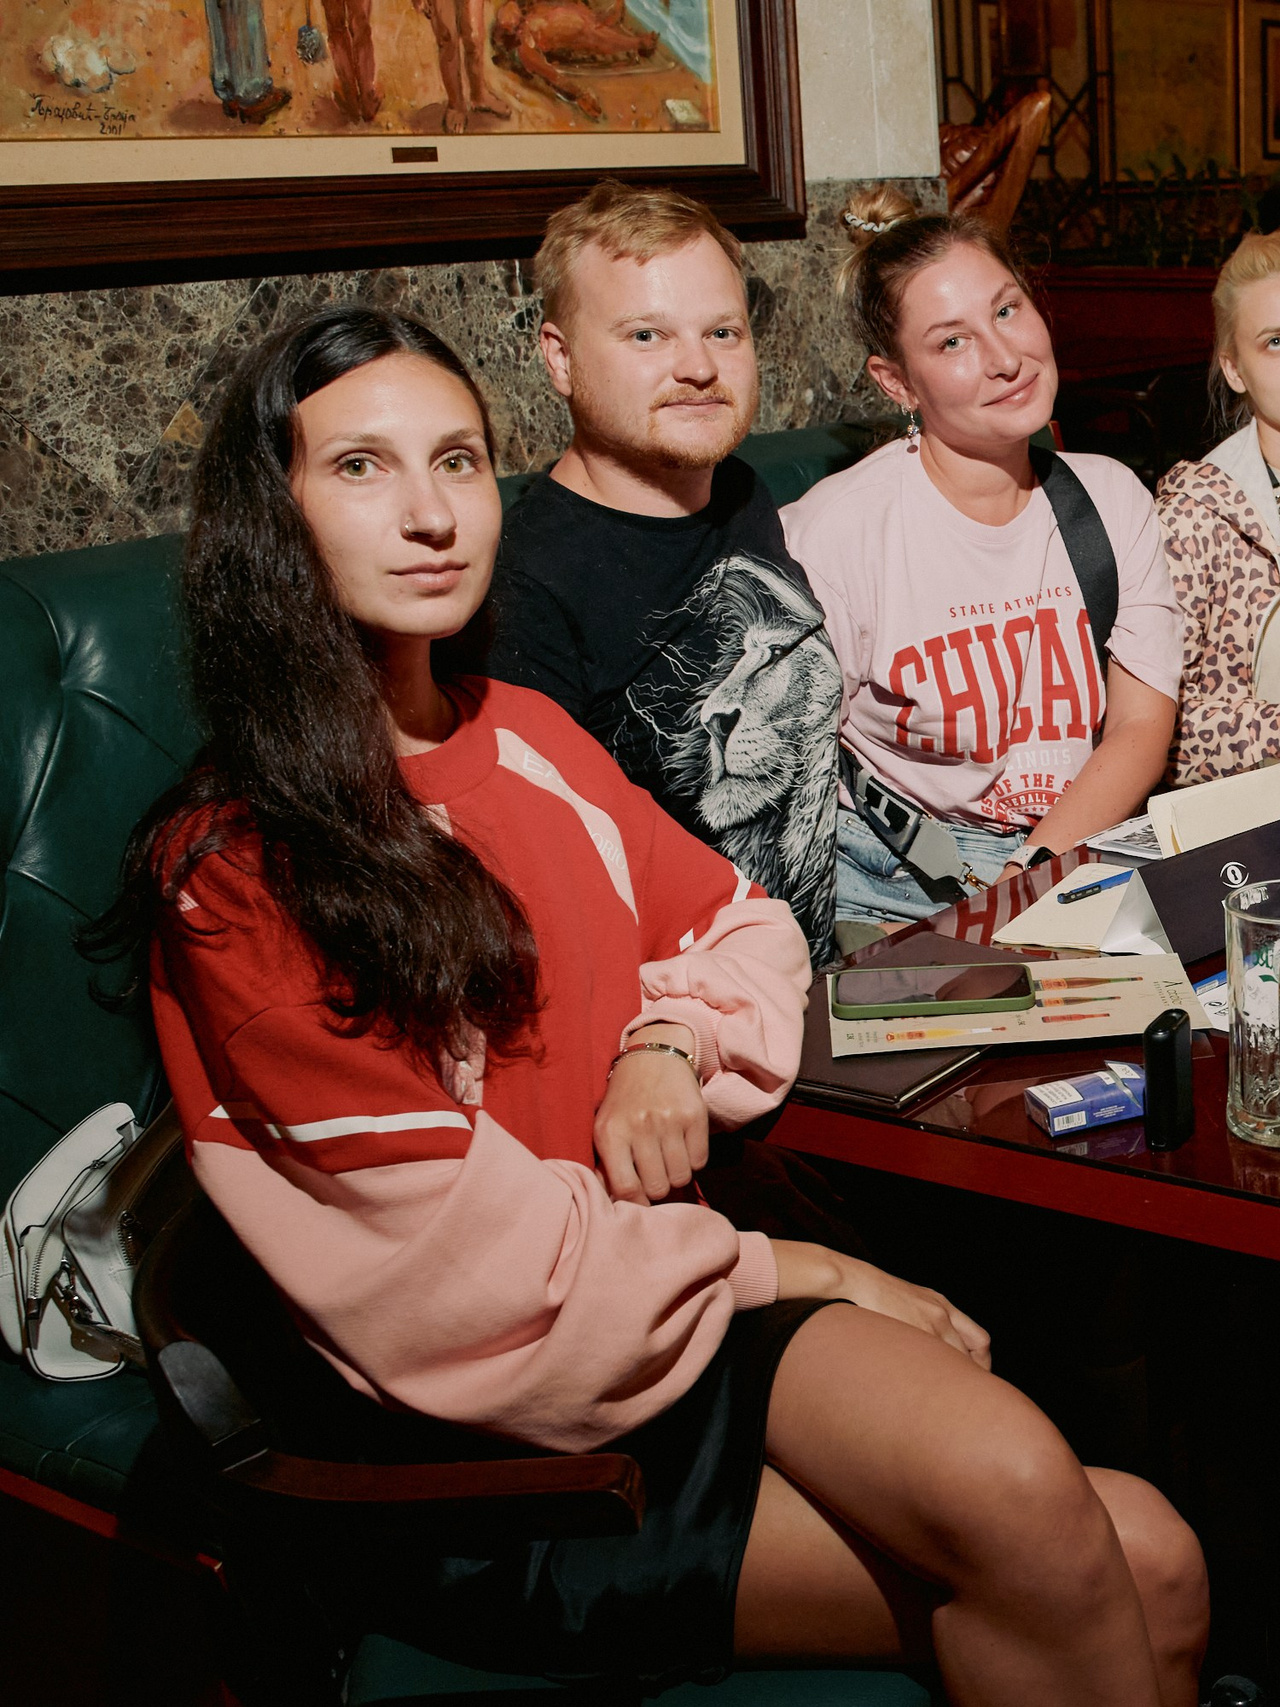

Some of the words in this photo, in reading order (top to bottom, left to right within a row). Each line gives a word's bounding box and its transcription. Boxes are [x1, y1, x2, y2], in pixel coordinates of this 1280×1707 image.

[949, 603, 995, 618] STATE
[992, 778, 1012, 798] OF
[1019, 772, 1055, 789] THE
